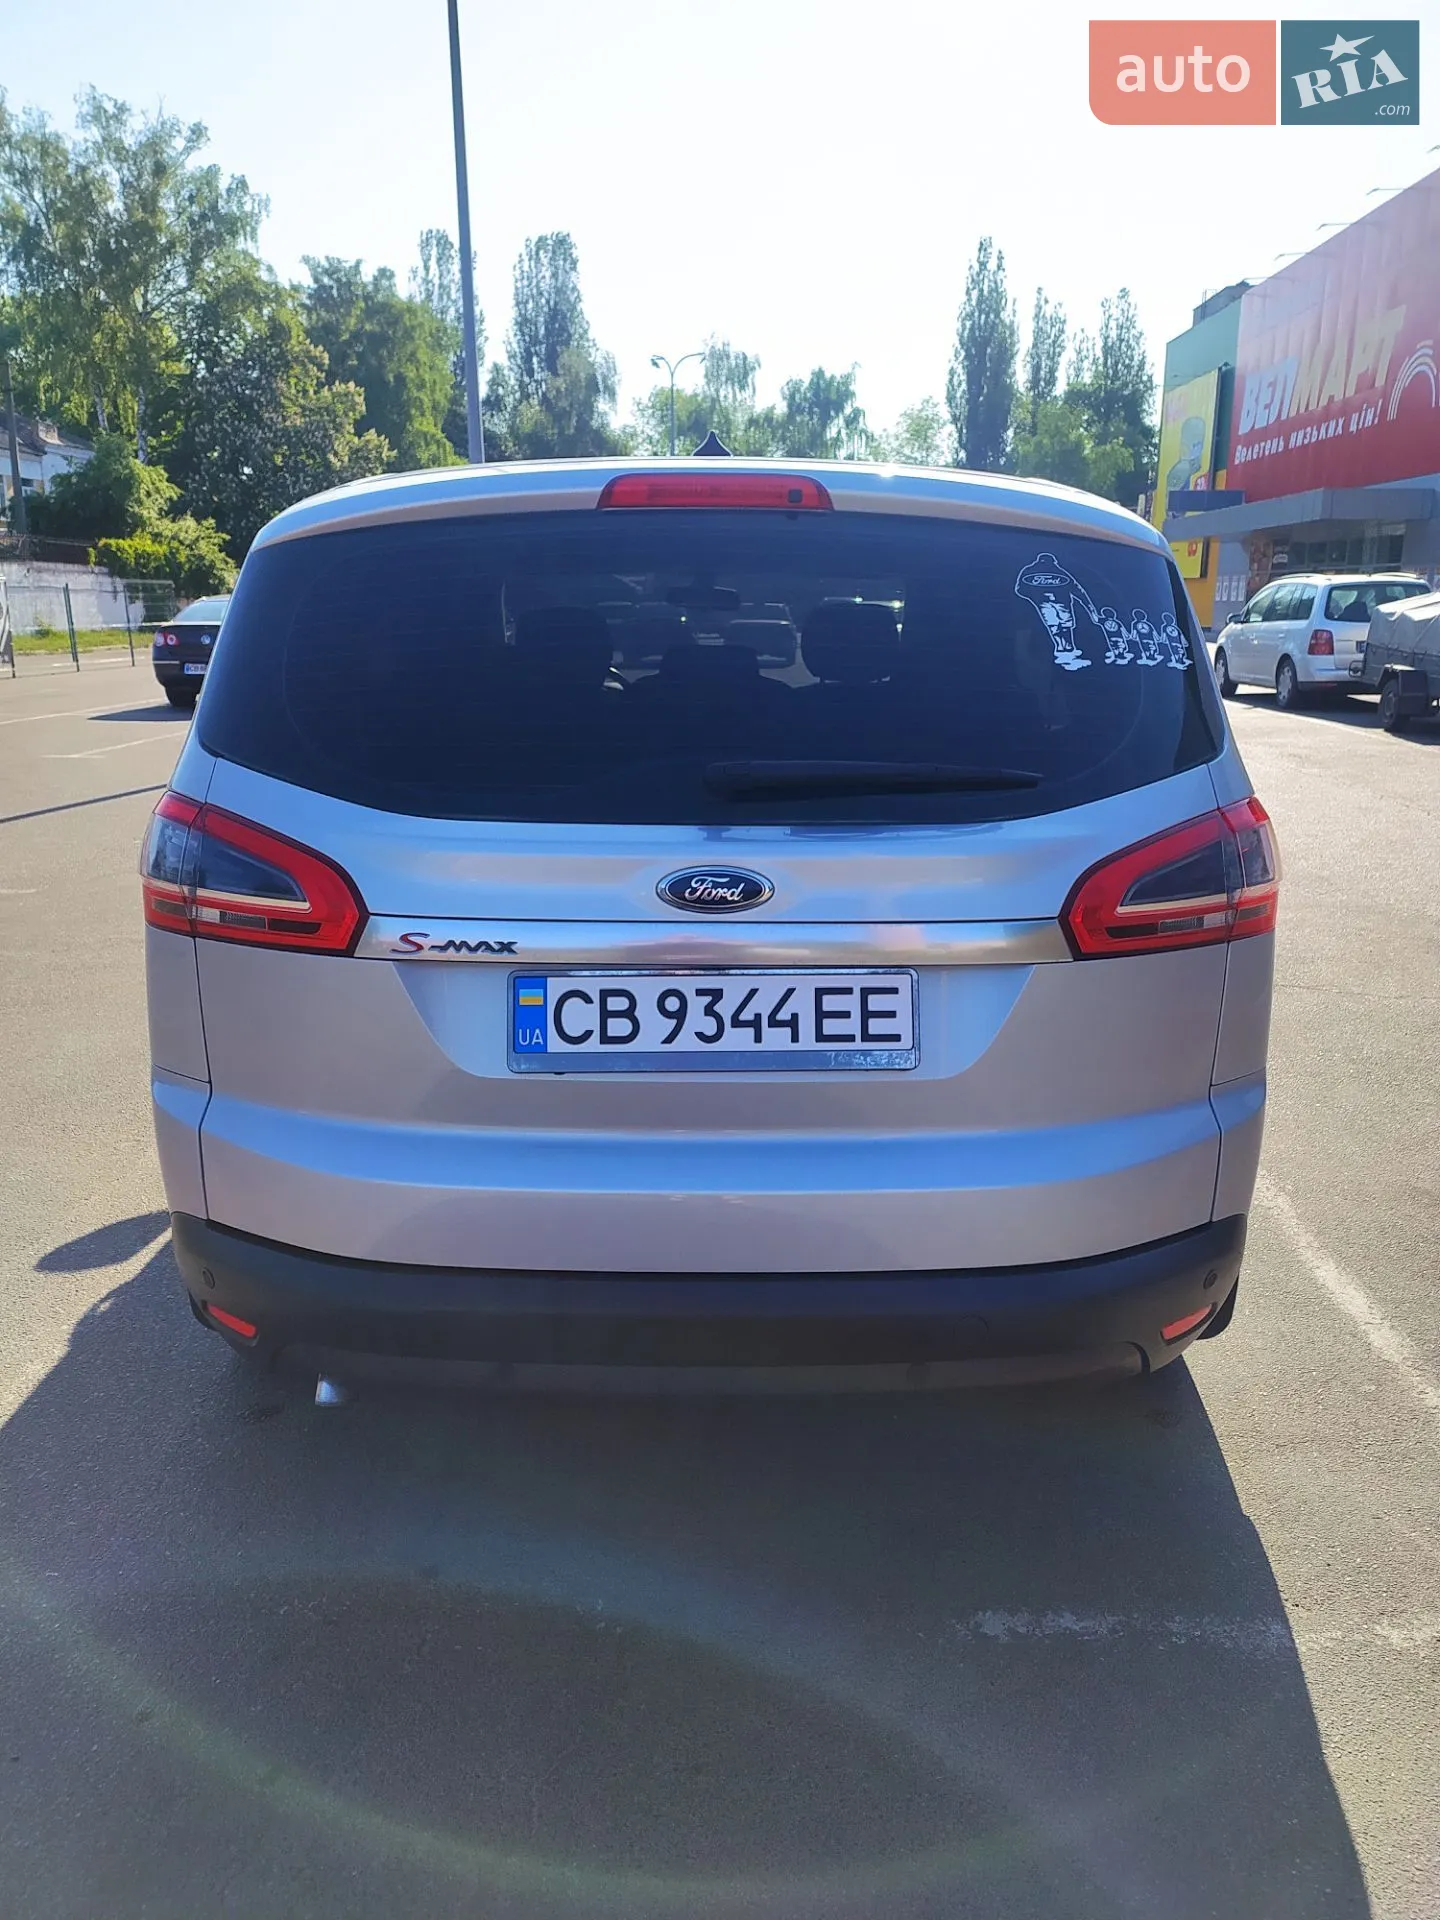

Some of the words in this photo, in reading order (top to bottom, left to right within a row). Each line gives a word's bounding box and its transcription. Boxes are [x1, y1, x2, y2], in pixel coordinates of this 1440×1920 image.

[1238, 304, 1407, 435] ВЕЛМАРТ
[1289, 416, 1345, 449] низьких
[1031, 575, 1062, 585] Ford
[684, 876, 744, 902] Ford
[389, 931, 519, 955] S-MAX
[553, 988, 641, 1045] CB
[656, 987, 800, 1045] 9344
[814, 986, 902, 1043] EE
[518, 1028, 544, 1046] UA
